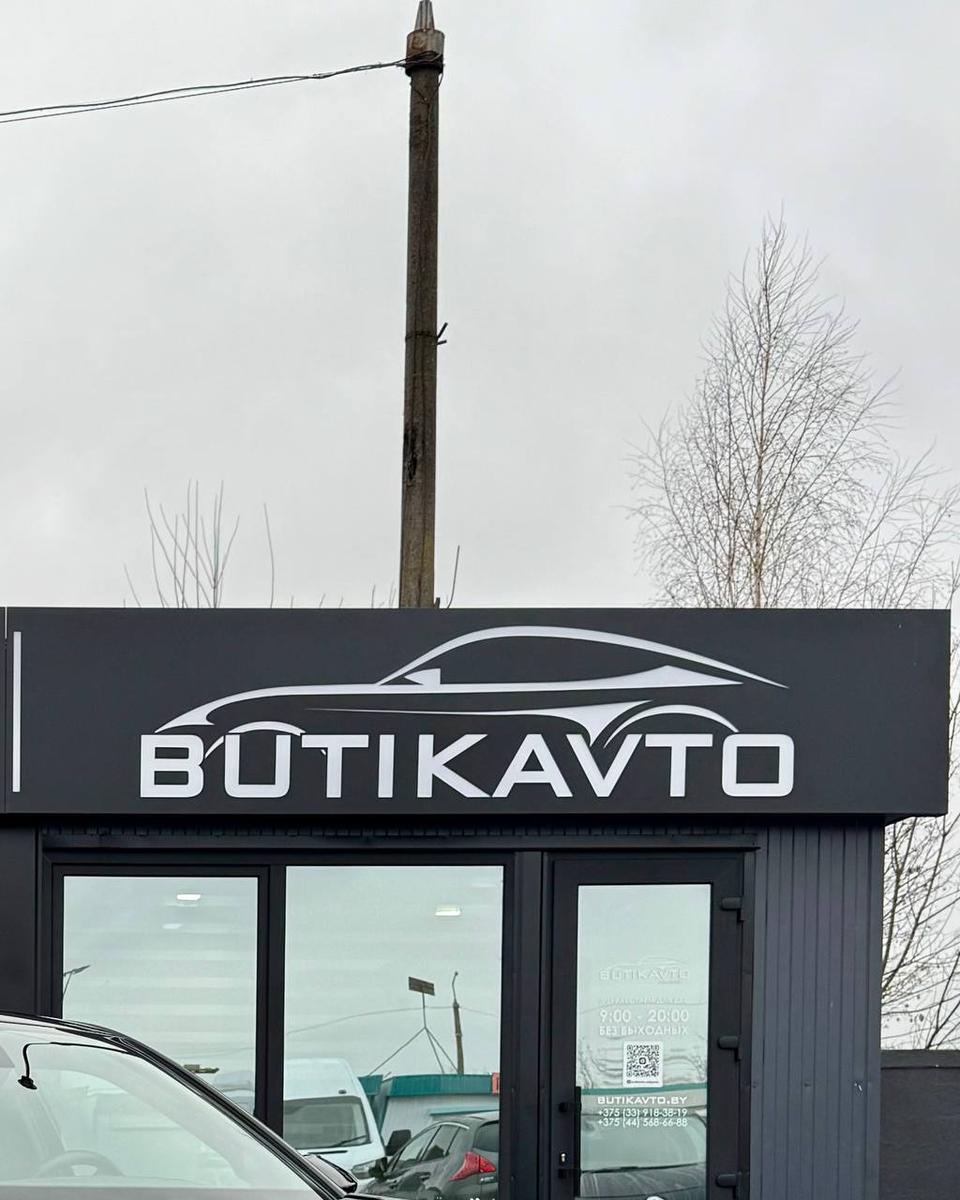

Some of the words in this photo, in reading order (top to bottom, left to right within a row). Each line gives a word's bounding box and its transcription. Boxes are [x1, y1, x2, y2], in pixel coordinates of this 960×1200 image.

[139, 732, 796, 799] BUTIKAVTO
[599, 1009, 632, 1023] 9:00
[648, 1009, 689, 1023] 20:00
[599, 1025, 617, 1036] БЕЗ
[621, 1025, 688, 1037] ВЫХОДНЫХ
[597, 1096, 688, 1105] BUTIKAVTO.BY
[598, 1108, 620, 1118] +375
[622, 1108, 640, 1119] (33)
[642, 1108, 688, 1117] 918-38-19
[598, 1118, 620, 1127] +375
[622, 1118, 640, 1129] (44)
